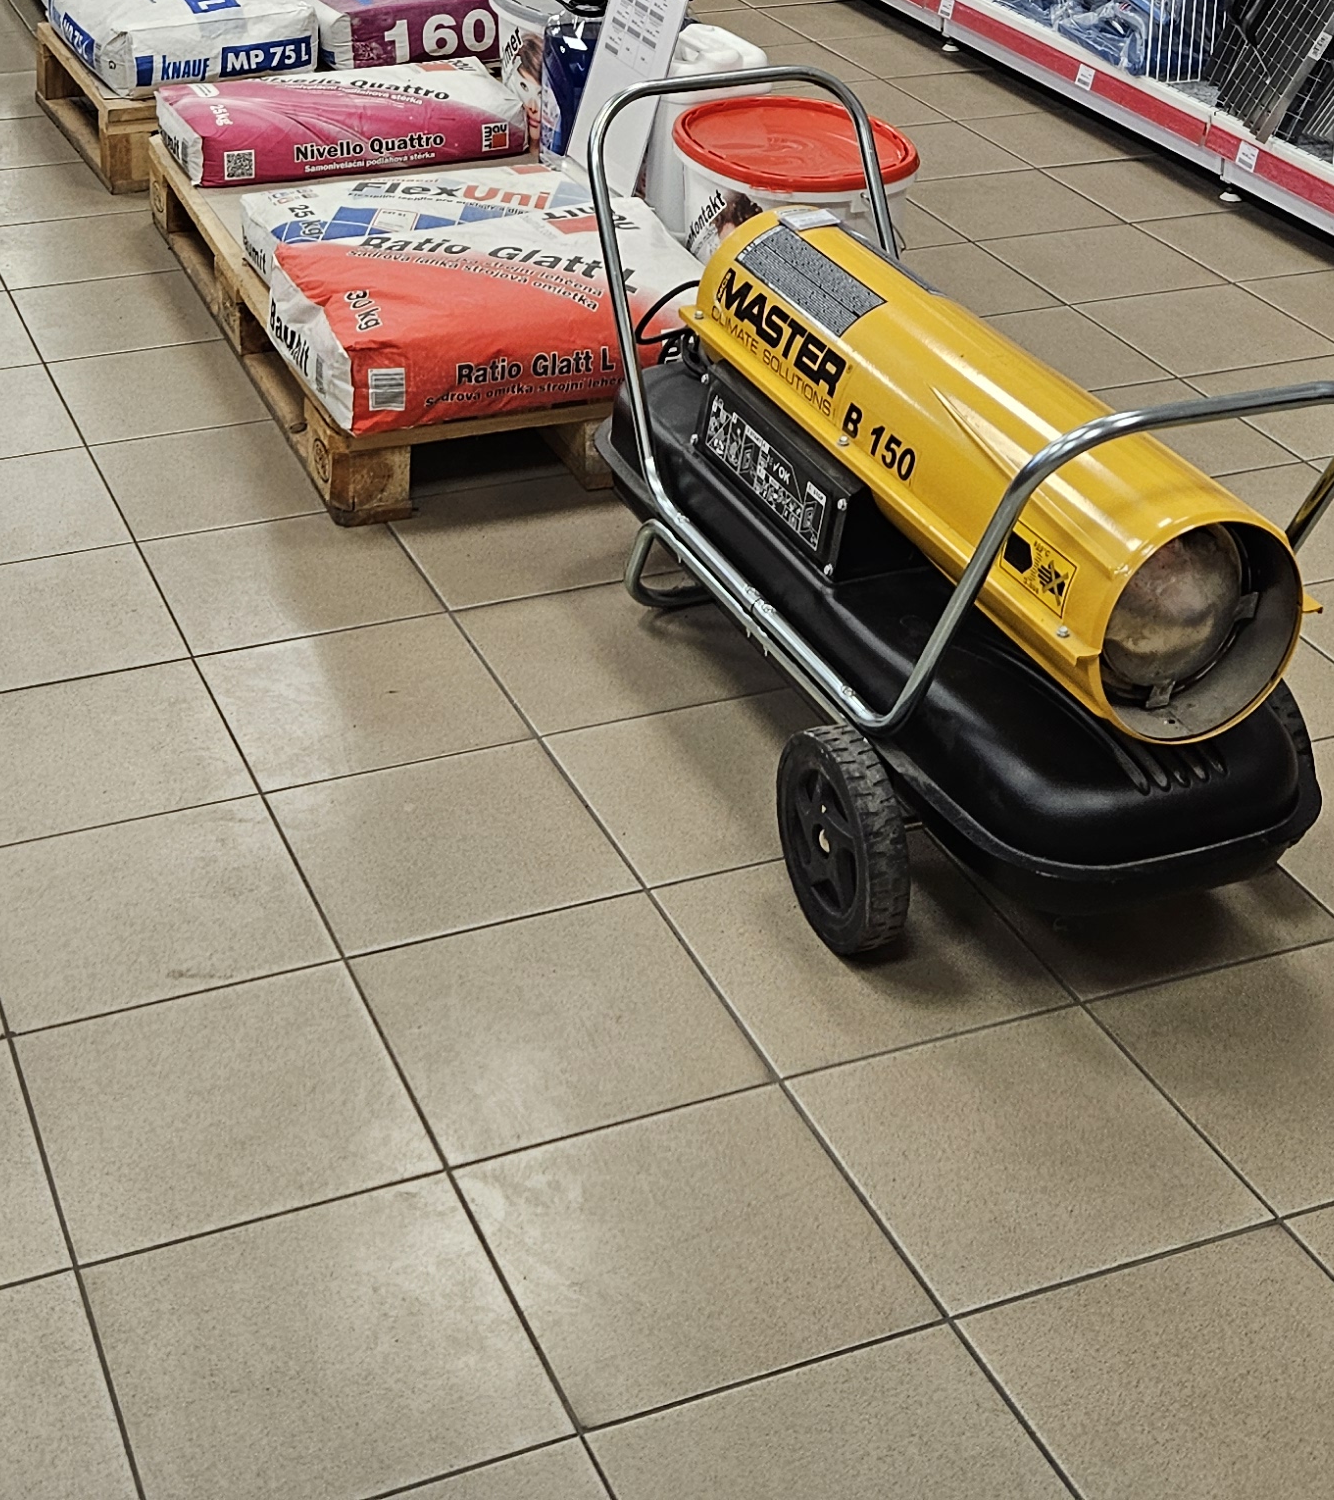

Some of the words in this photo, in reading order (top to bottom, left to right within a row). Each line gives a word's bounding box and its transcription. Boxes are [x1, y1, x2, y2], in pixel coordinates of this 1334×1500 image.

[385, 8, 496, 63] 160
[161, 54, 210, 81] KNAUF
[226, 49, 265, 72] MP
[270, 45, 296, 67] 75
[300, 42, 310, 61] L
[350, 79, 451, 101] Quattro
[293, 140, 364, 164] Nivello
[369, 132, 445, 154] Quattro
[351, 181, 551, 211] FlexUni
[288, 204, 315, 219] 25
[302, 219, 324, 240] kg
[358, 235, 472, 255] Ratio
[487, 246, 607, 280] Glatt
[345, 289, 369, 310] 30
[357, 308, 383, 333] kg
[531, 279, 600, 312] omietka
[718, 268, 848, 399] MASTER
[456, 356, 523, 386] Ratio
[532, 350, 593, 379] Glatt
[600, 346, 616, 373] L
[710, 306, 758, 355] CLIMATE
[762, 348, 832, 418] SOLUTIONS
[843, 402, 863, 440] B
[870, 425, 916, 482] 150
[778, 466, 791, 485] OK
